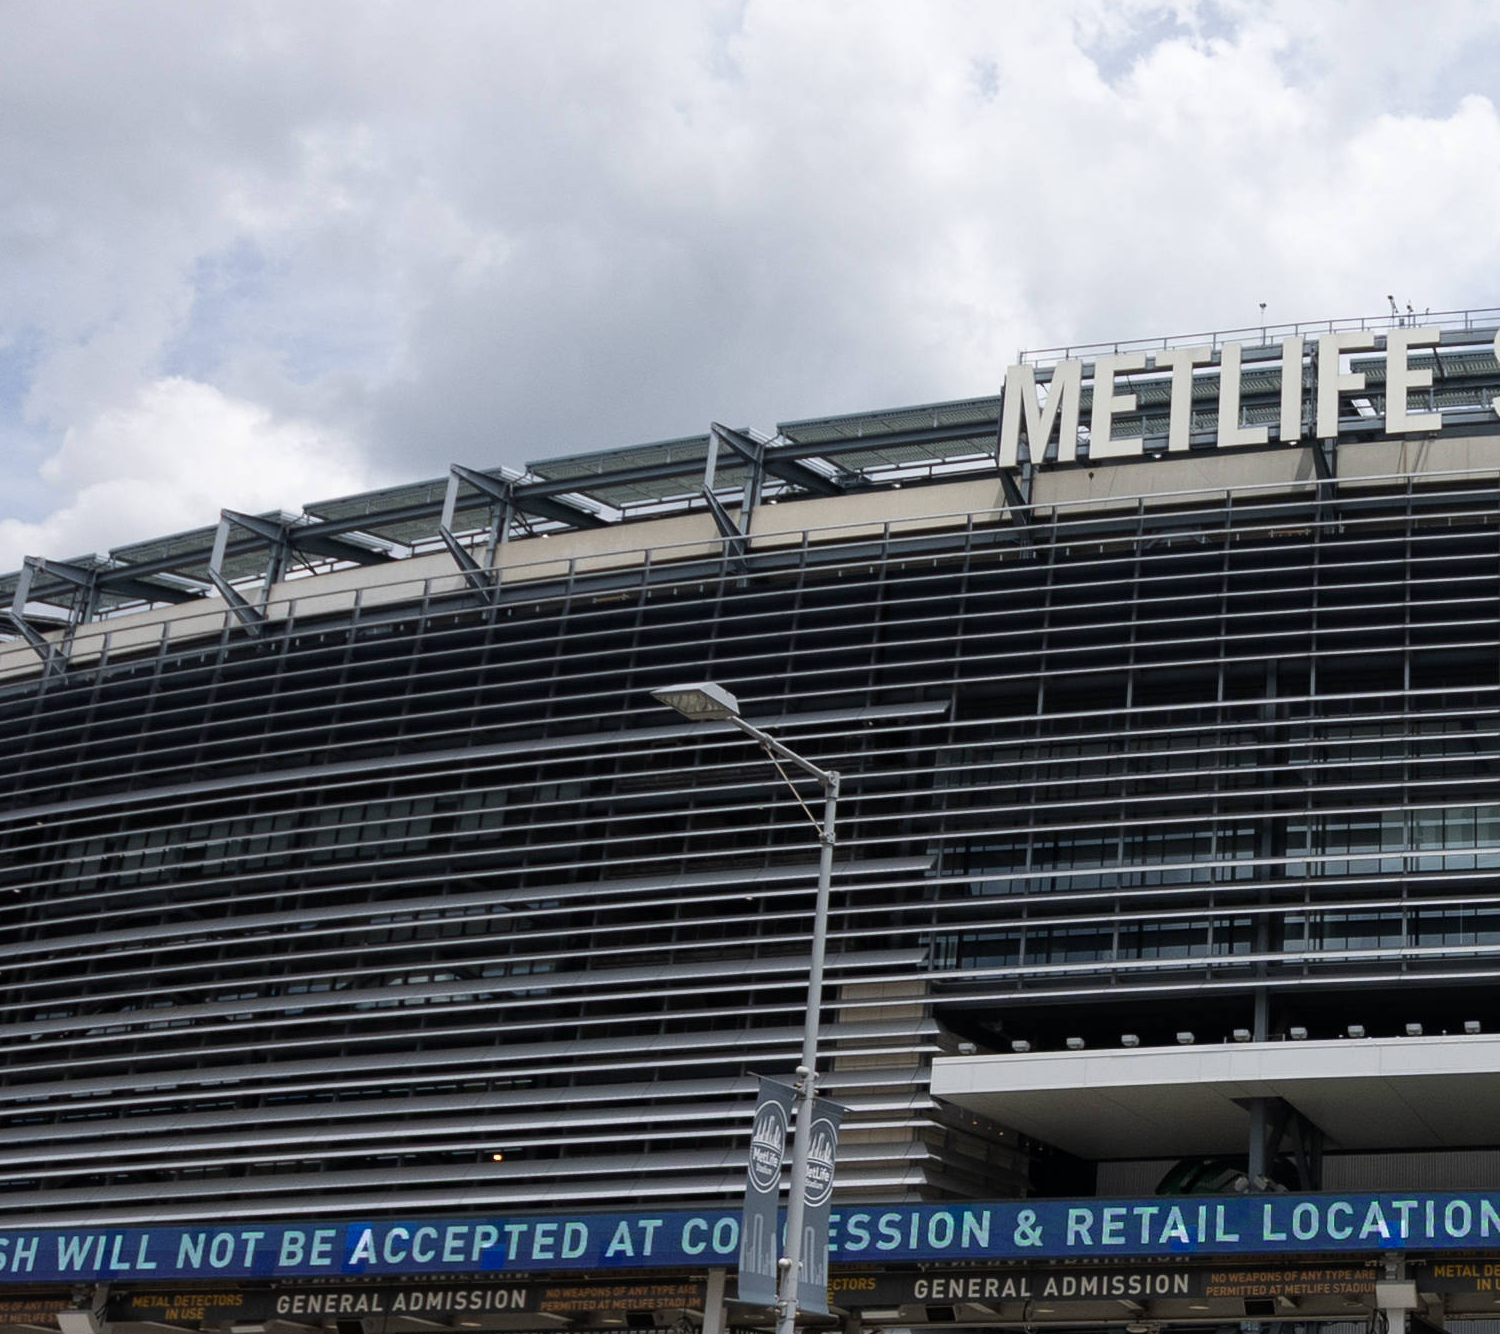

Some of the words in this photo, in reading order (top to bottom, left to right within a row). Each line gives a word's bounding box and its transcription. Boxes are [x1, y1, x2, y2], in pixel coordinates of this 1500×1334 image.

[1000, 327, 1442, 467] METLIFE
[752, 1147, 779, 1168] MetLife
[57, 1234, 159, 1271] WILL
[176, 1231, 265, 1269] NOT
[278, 1229, 337, 1266] BE
[349, 1222, 589, 1265] ACCEPTED
[605, 1219, 663, 1259] AT
[1013, 1209, 1043, 1248] &
[1067, 1204, 1239, 1246] RETAIL
[1211, 1274, 1225, 1283] NO
[1228, 1272, 1281, 1282] WEAPONS
[1283, 1271, 1298, 1281] OF
[1301, 1271, 1323, 1281] ANY
[1325, 1270, 1351, 1280] TYPE
[1354, 1269, 1376, 1279] ARE
[1435, 1265, 1480, 1278] METAL
[914, 1277, 1031, 1299] GENERAL
[1042, 1274, 1189, 1297] ADMISSION
[1206, 1286, 1267, 1296] PERMITTED
[1269, 1285, 1281, 1294] AT
[1285, 1284, 1330, 1294] METLIFE
[1477, 1278, 1492, 1291] IN
[132, 1297, 171, 1308] METAL
[174, 1294, 243, 1307] DETECTORS
[276, 1294, 383, 1314] GENERAL
[393, 1289, 527, 1311] ADMISSION
[165, 1309, 176, 1320] IN
[178, 1307, 205, 1319] USE
